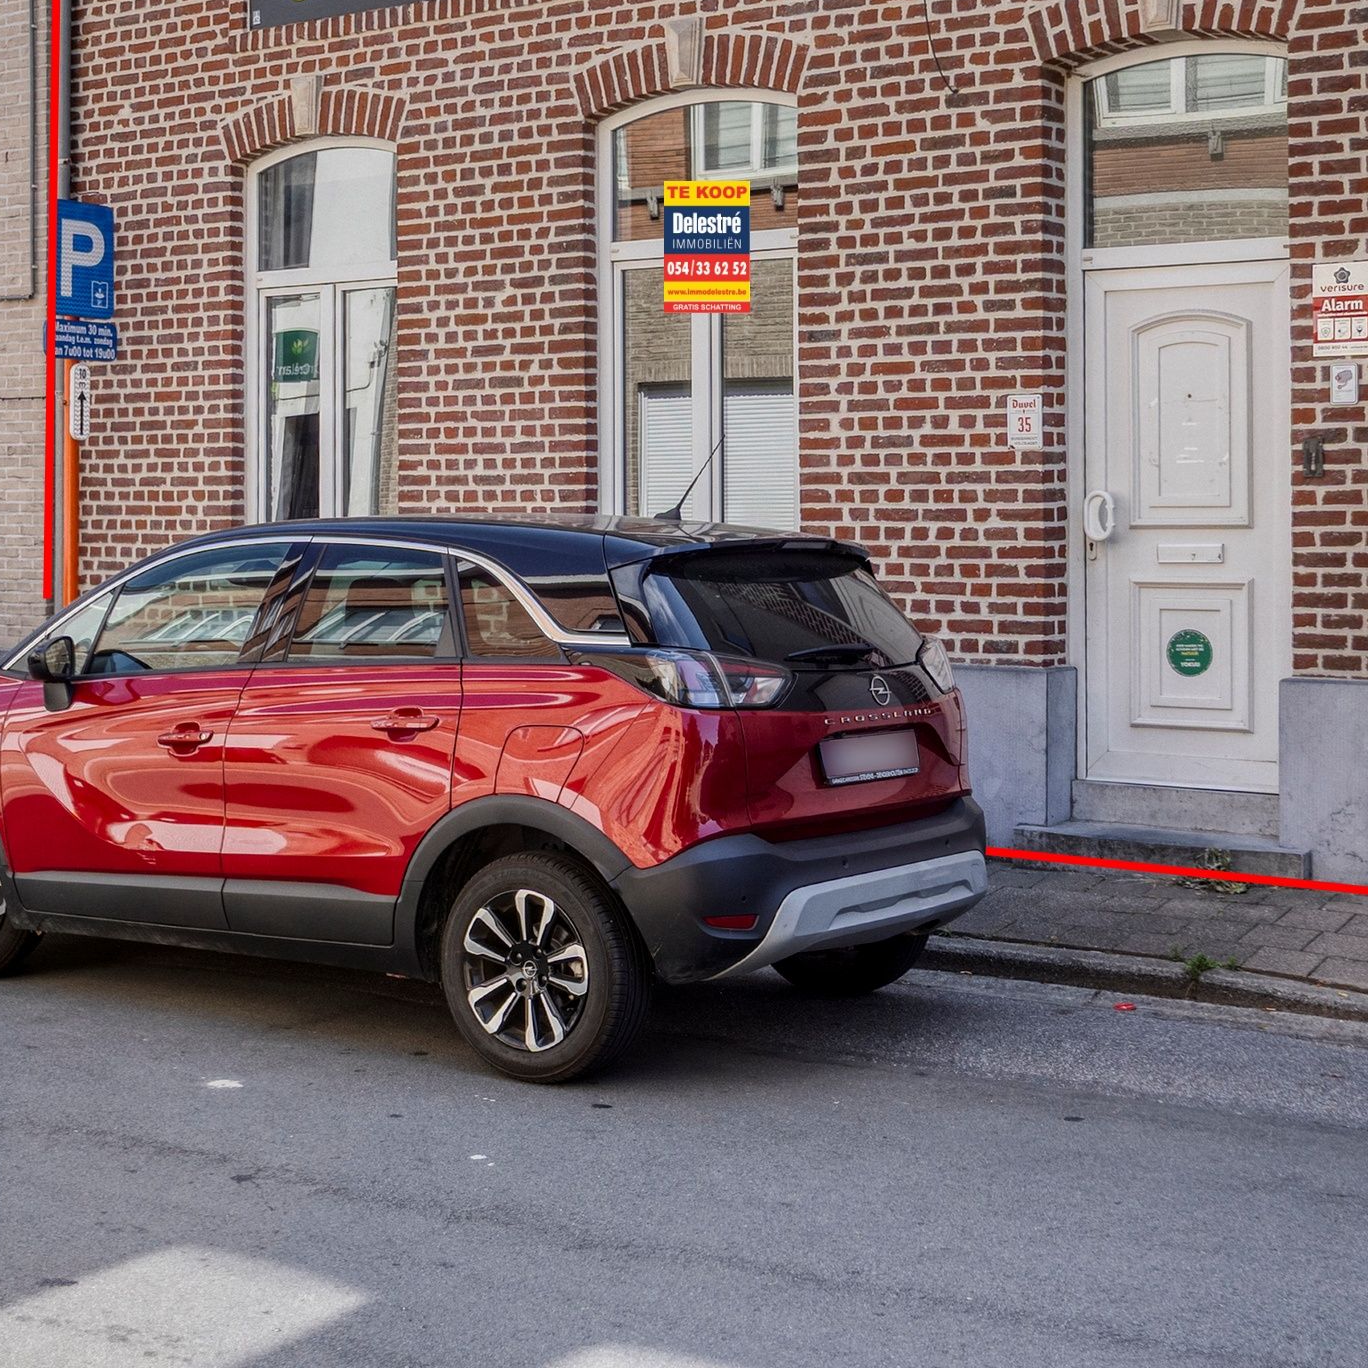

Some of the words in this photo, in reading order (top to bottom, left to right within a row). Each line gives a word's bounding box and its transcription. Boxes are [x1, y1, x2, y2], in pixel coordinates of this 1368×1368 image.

[61, 218, 105, 297] P
[1320, 283, 1365, 292] verisure
[1321, 298, 1363, 312] Alarm
[88, 324, 97, 335] 30
[55, 334, 75, 344] aandag
[64, 345, 82, 357] 7u00
[83, 347, 93, 358] tot
[1012, 399, 1036, 409] Duvel
[1018, 417, 1031, 432] 35
[824, 708, 931, 725] CROSSLAND
